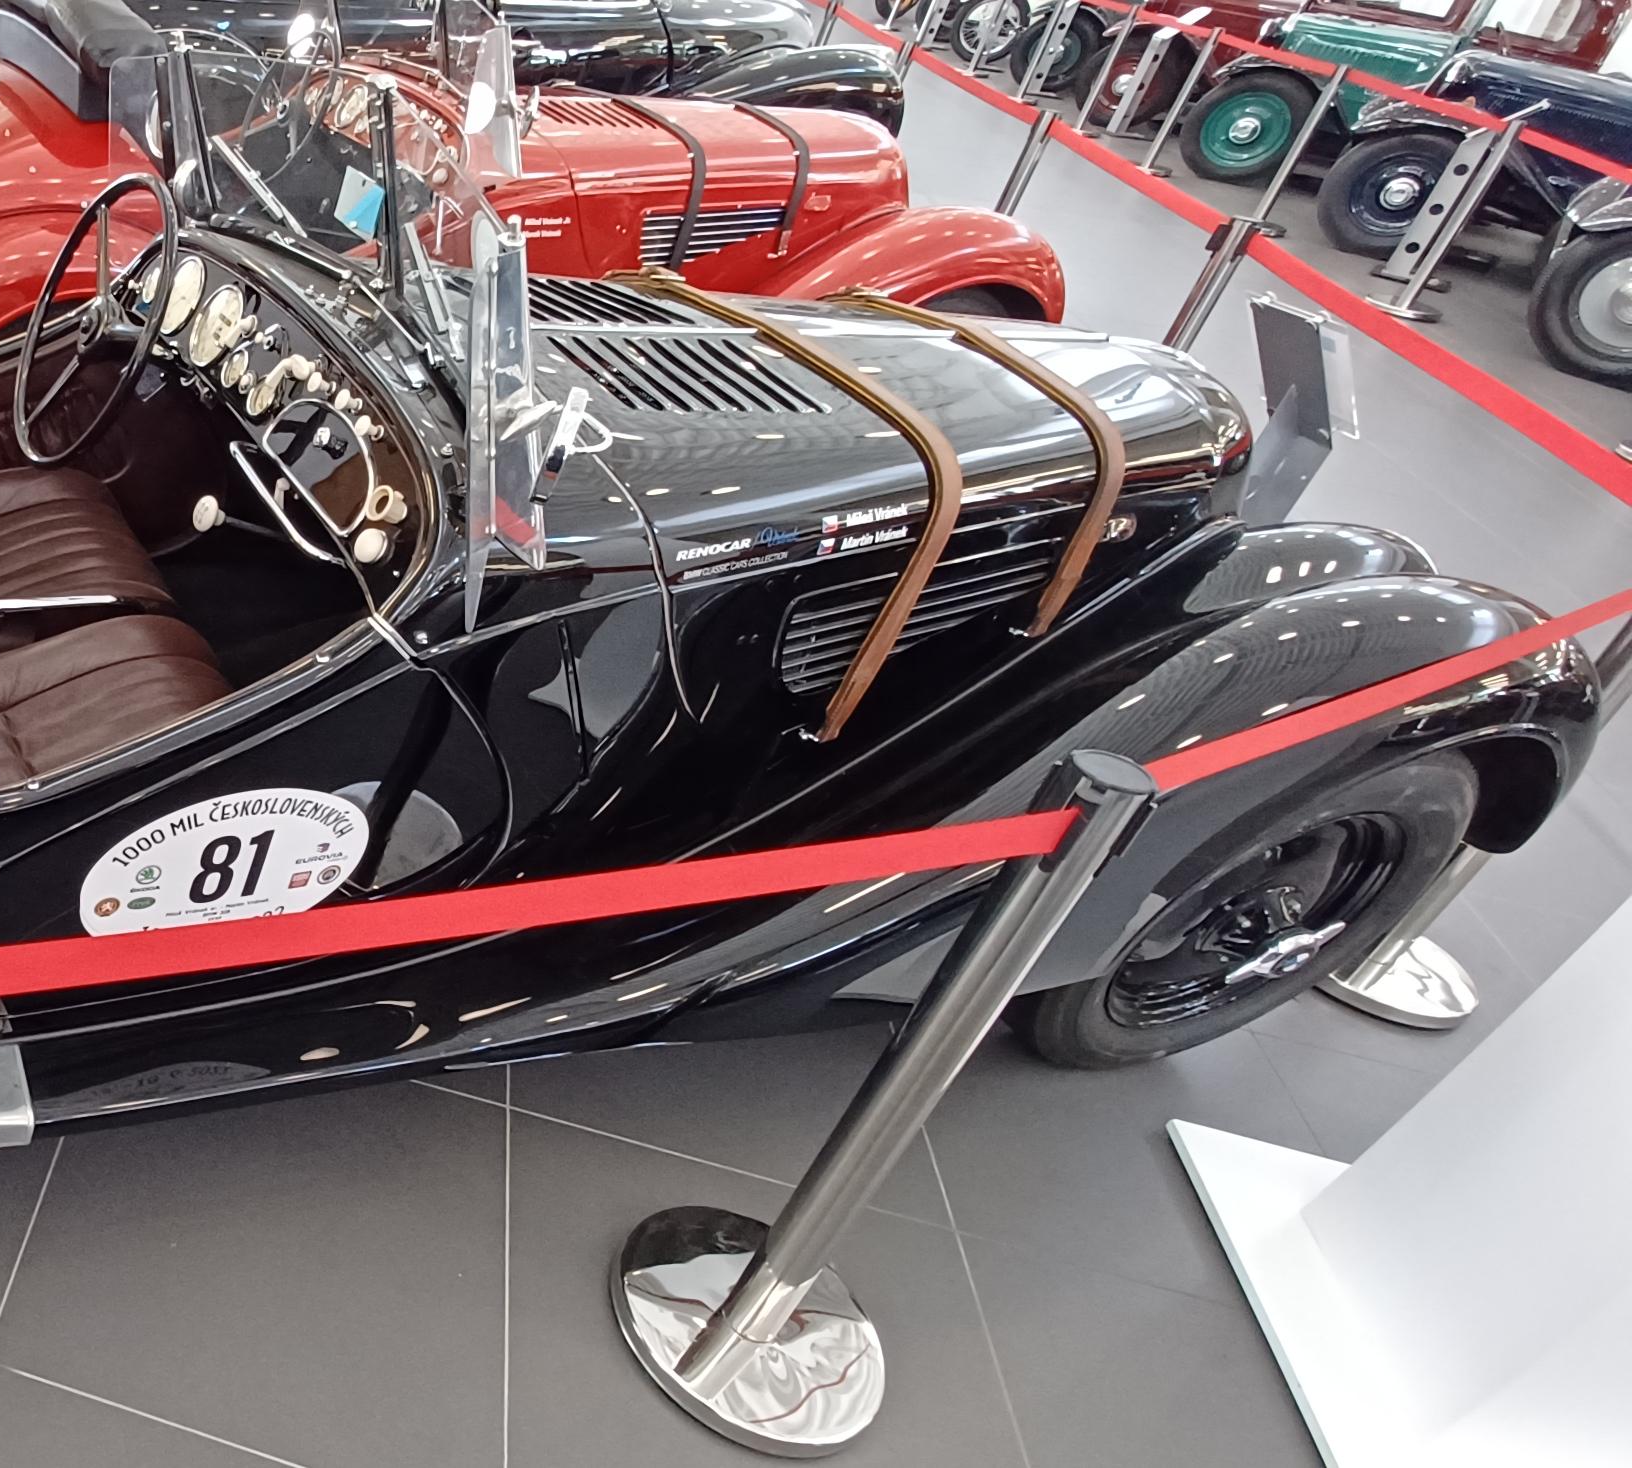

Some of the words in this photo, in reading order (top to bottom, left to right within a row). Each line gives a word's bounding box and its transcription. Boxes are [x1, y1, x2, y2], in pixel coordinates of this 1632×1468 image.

[874, 503, 908, 521] Vránek
[676, 538, 751, 561] RENOCAR
[840, 532, 874, 550] Martin
[875, 526, 908, 543] Vránek
[702, 563, 730, 576] CLASSIC
[730, 560, 748, 571] CARS
[747, 552, 788, 567] COLLECTION
[112, 829, 166, 867] 1000
[169, 813, 205, 836] MIL
[209, 797, 354, 838] ČESKOSLOVENSKÝCH
[189, 829, 275, 904] 81
[295, 852, 343, 864] EUROVIA
